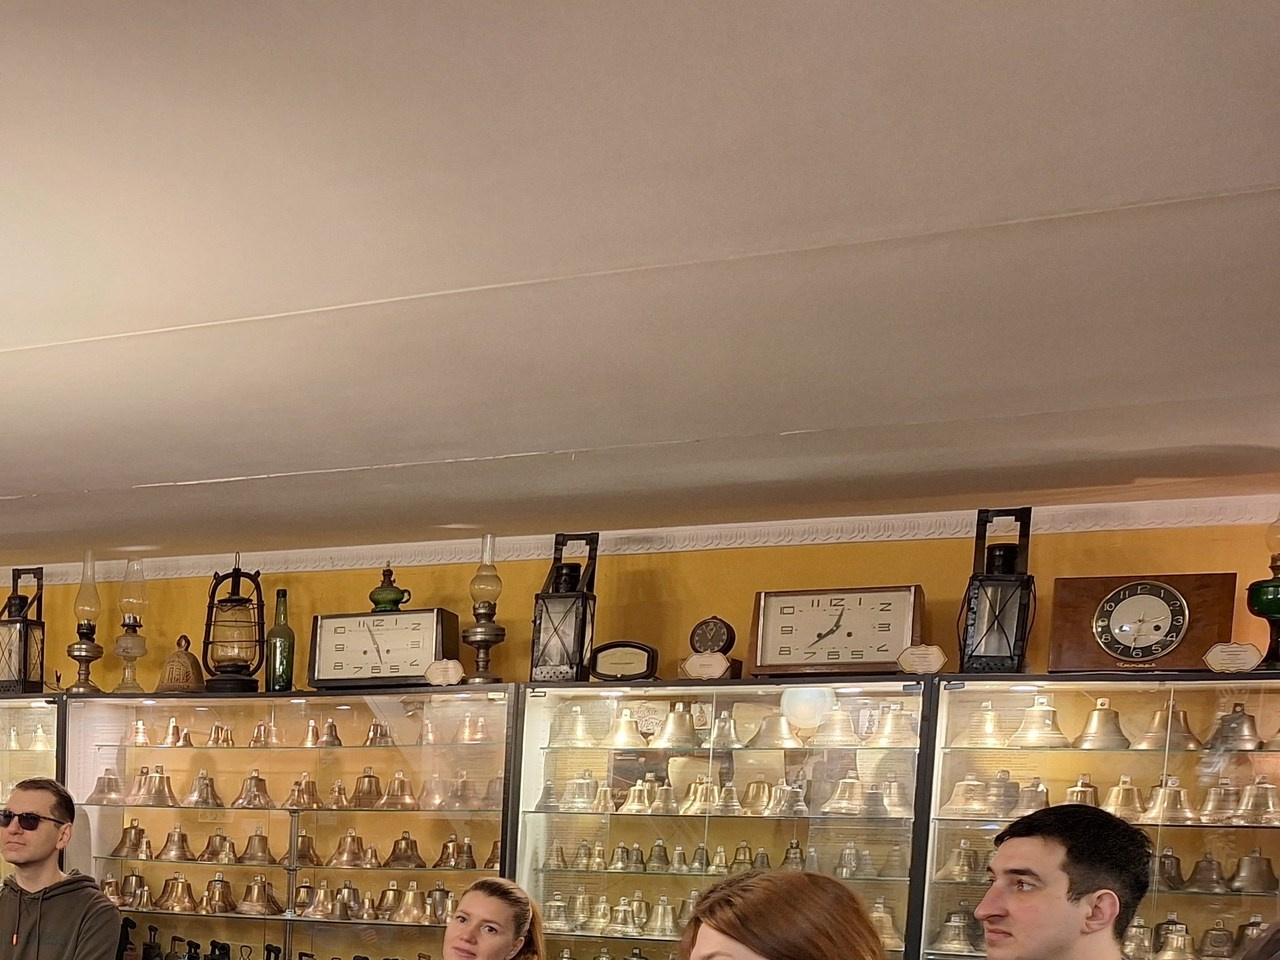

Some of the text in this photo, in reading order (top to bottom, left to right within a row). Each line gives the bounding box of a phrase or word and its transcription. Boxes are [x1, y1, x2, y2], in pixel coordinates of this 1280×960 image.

[1137, 585, 1150, 594] 12
[830, 598, 845, 606] 12
[1170, 601, 1180, 609] 2
[780, 606, 795, 615] 10
[880, 603, 892, 611] 2
[1104, 602, 1115, 611] 10
[1098, 618, 1108, 626] 9
[1173, 616, 1183, 625] 3
[781, 626, 793, 634] 9
[1102, 634, 1111, 642] 8
[779, 646, 791, 655] 8
[1114, 645, 1124, 653] 7
[1132, 649, 1142, 657] 6
[1152, 645, 1162, 653] 5
[804, 652, 816, 660] 7
[827, 651, 840, 659] 6
[851, 651, 864, 659] 5
[390, 665, 400, 673] 5
